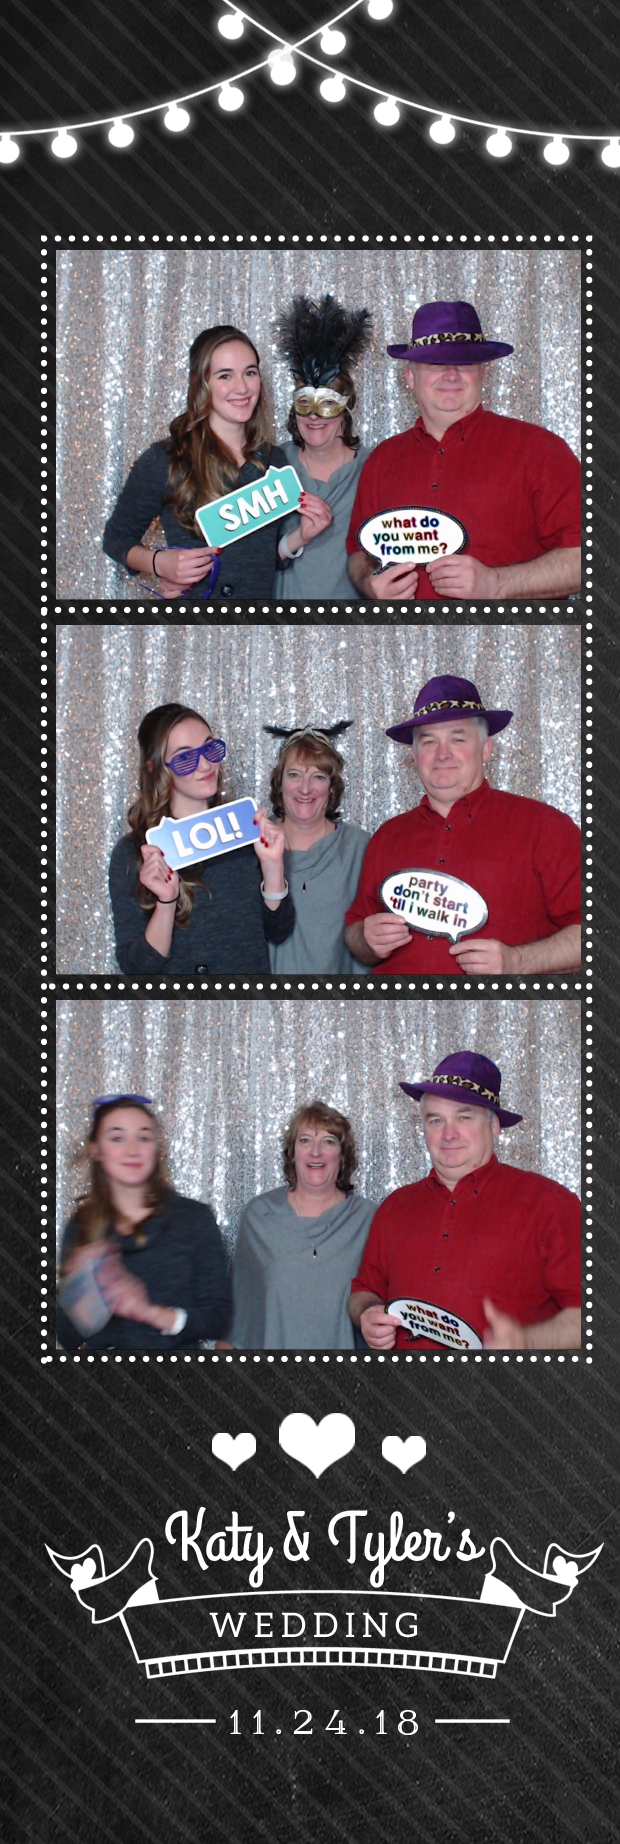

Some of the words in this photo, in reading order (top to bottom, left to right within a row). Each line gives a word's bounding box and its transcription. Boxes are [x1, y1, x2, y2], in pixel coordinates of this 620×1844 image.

[218, 479, 289, 531] SMH
[381, 516, 417, 528] what
[419, 516, 440, 528] do
[373, 532, 400, 544] you
[402, 529, 439, 542] want
[380, 543, 415, 556] from
[417, 542, 448, 555] me?
[171, 811, 243, 858] LOL!
[409, 876, 448, 896] party
[393, 884, 430, 903] don't
[433, 897, 469, 914] start
[409, 902, 414, 913] i
[417, 906, 449, 923] walk
[453, 914, 467, 928] in
[400, 1310, 425, 1323] you
[427, 1319, 461, 1337] want
[406, 1304, 439, 1320] what
[441, 1315, 459, 1327] do
[409, 1320, 441, 1337] from
